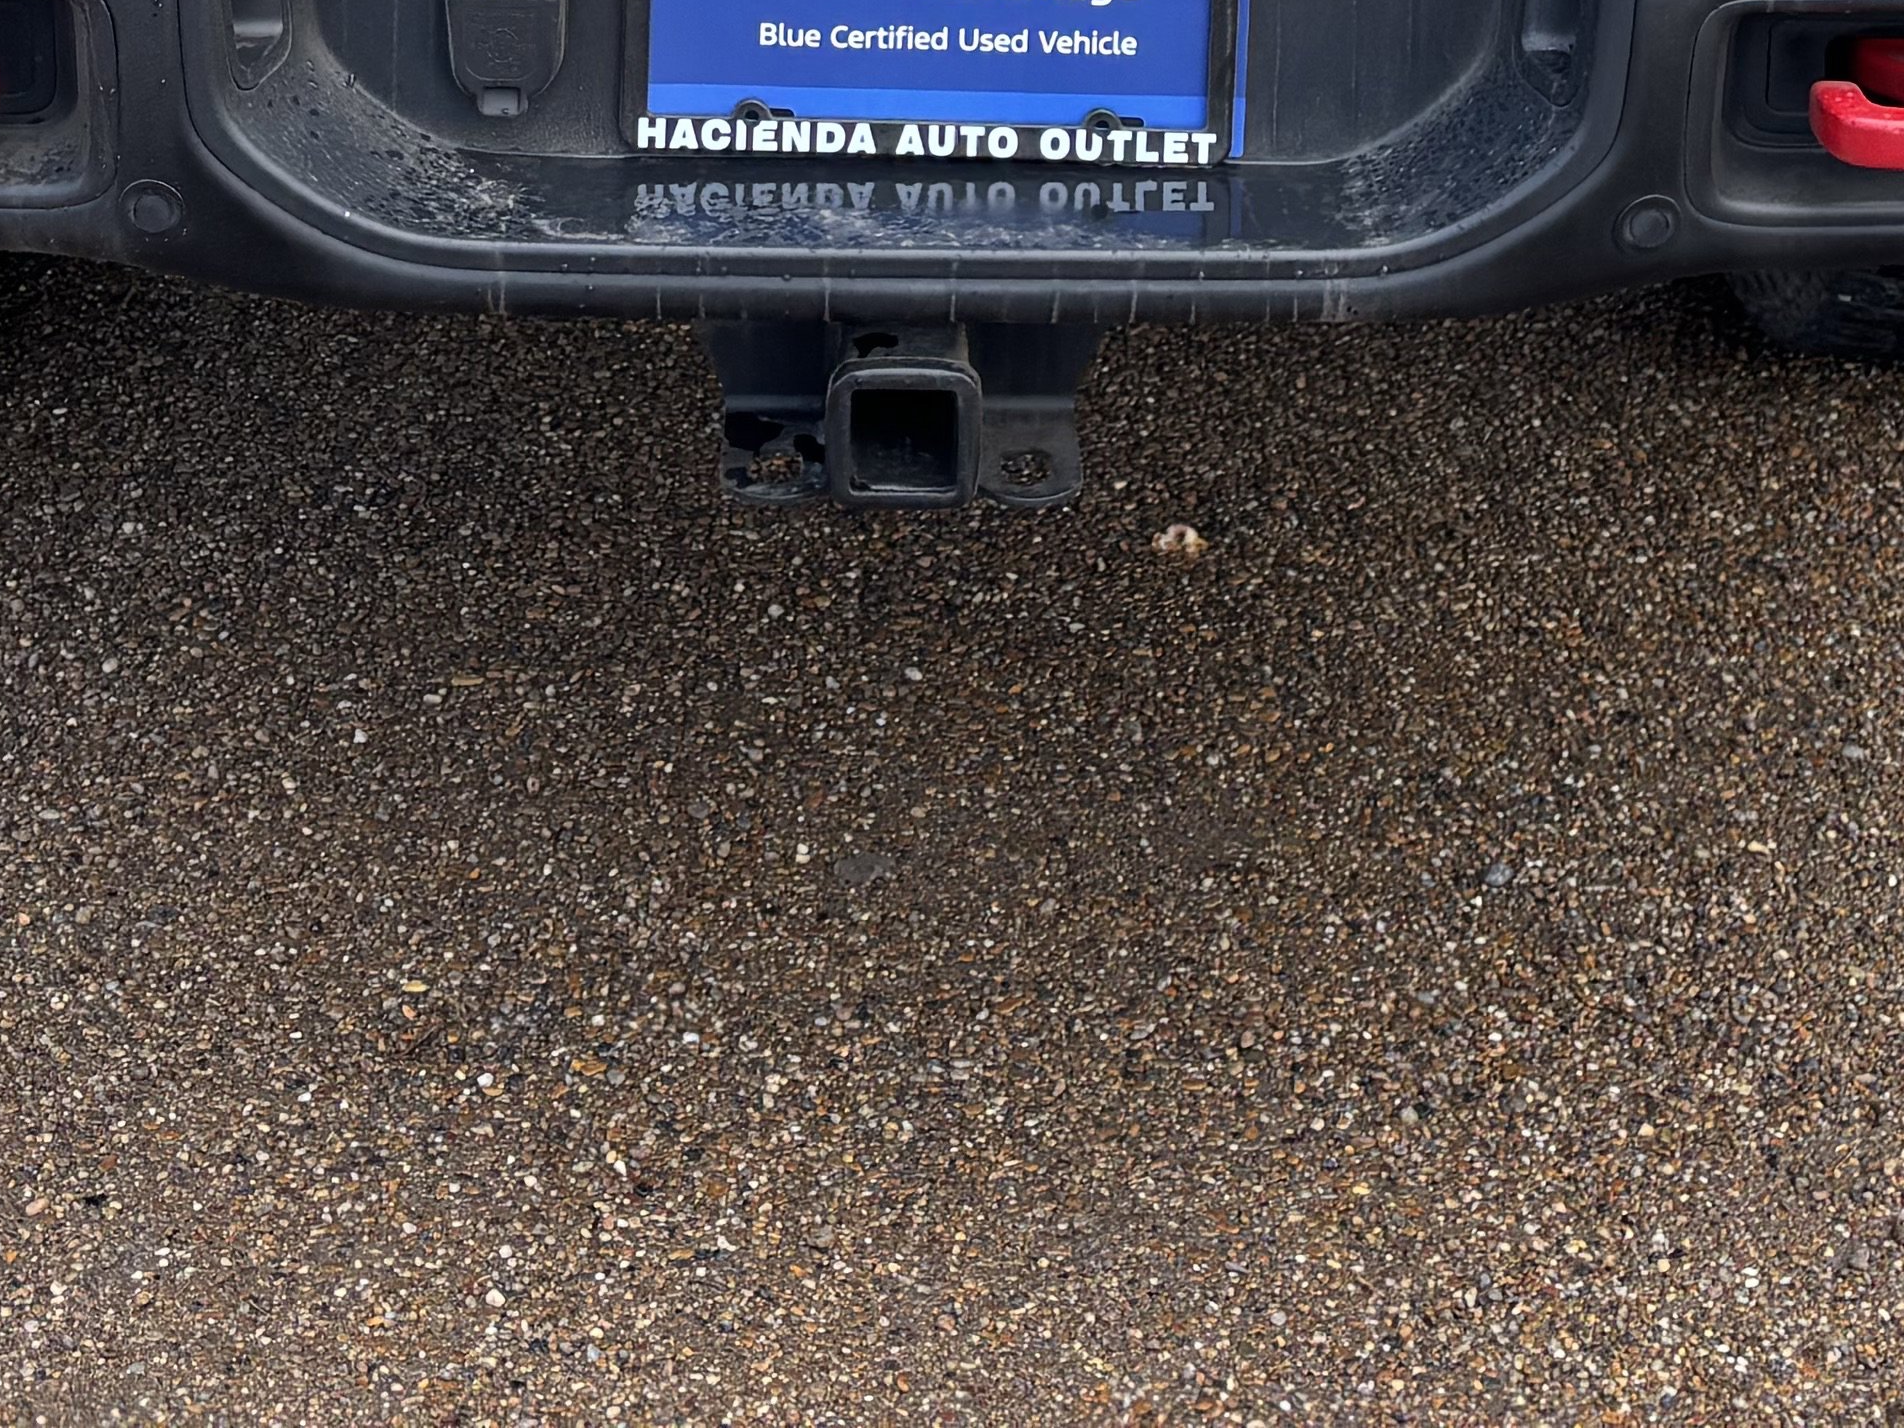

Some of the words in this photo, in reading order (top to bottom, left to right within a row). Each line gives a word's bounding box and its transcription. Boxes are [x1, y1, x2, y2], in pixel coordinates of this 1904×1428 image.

[759, 23, 820, 48] Blue
[830, 25, 948, 52] Certified
[959, 28, 1028, 54] Used
[1038, 30, 1138, 57] Vehicle
[637, 117, 877, 156] HACIENDA
[895, 124, 1019, 159] AUTO
[1039, 128, 1217, 165] OUTLET
